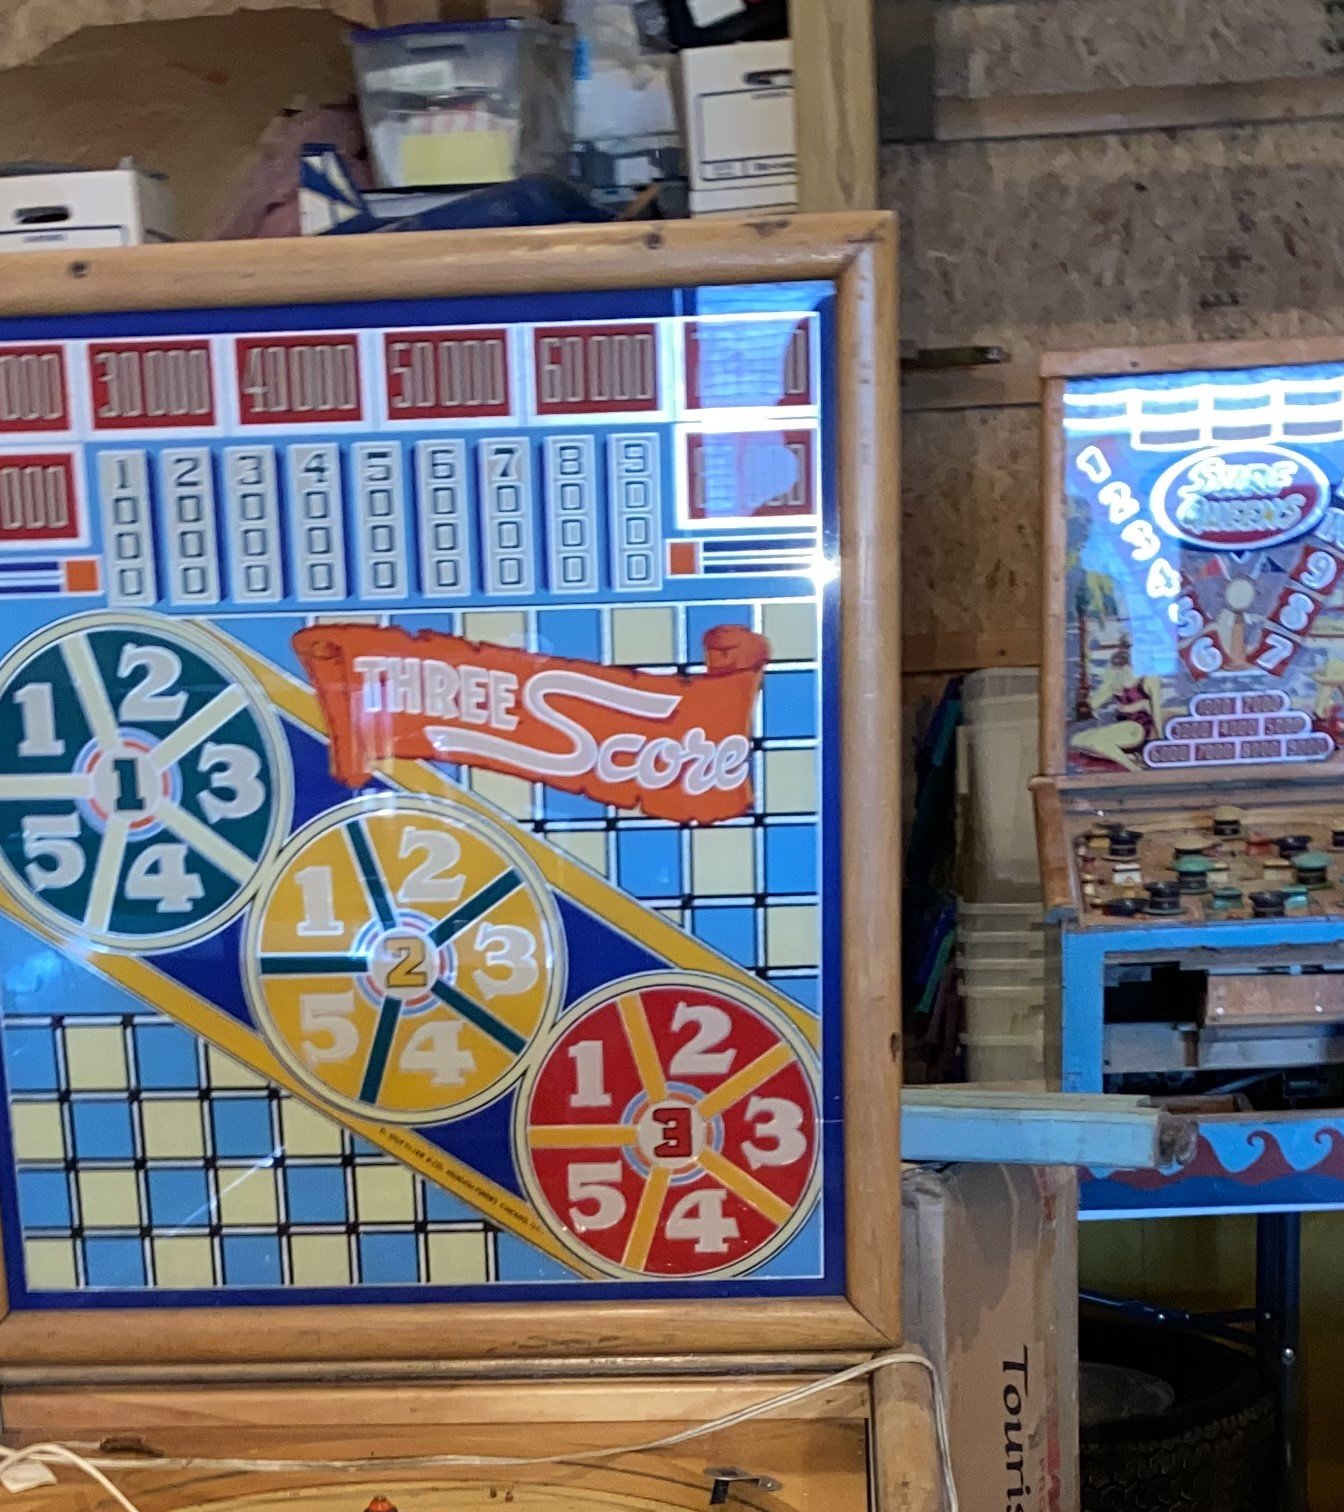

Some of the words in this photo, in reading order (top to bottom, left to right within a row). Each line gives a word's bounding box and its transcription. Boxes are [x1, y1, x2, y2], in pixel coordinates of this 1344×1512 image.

[1300, 551, 1338, 586] 9
[1280, 593, 1315, 632] 8
[116, 643, 186, 724] 2
[1191, 637, 1223, 672] 6
[1256, 633, 1294, 669] 7
[13, 682, 66, 758] 1
[353, 655, 520, 732] THREE
[422, 669, 752, 796] Score
[112, 758, 148, 812] 1
[196, 742, 266, 824] 3
[22, 813, 87, 893] 5
[125, 842, 204, 915] 4
[398, 826, 467, 905] 2
[294, 864, 346, 938] 1
[383, 936, 428, 989] 2
[471, 921, 540, 1000] 3
[299, 986, 361, 1065] 5
[398, 1020, 477, 1089] 4
[670, 1002, 738, 1077] 2
[567, 1040, 613, 1109] 1
[651, 1107, 693, 1159] 3
[739, 1095, 808, 1168] 3
[567, 1160, 627, 1234] 5
[664, 1190, 741, 1256] 4
